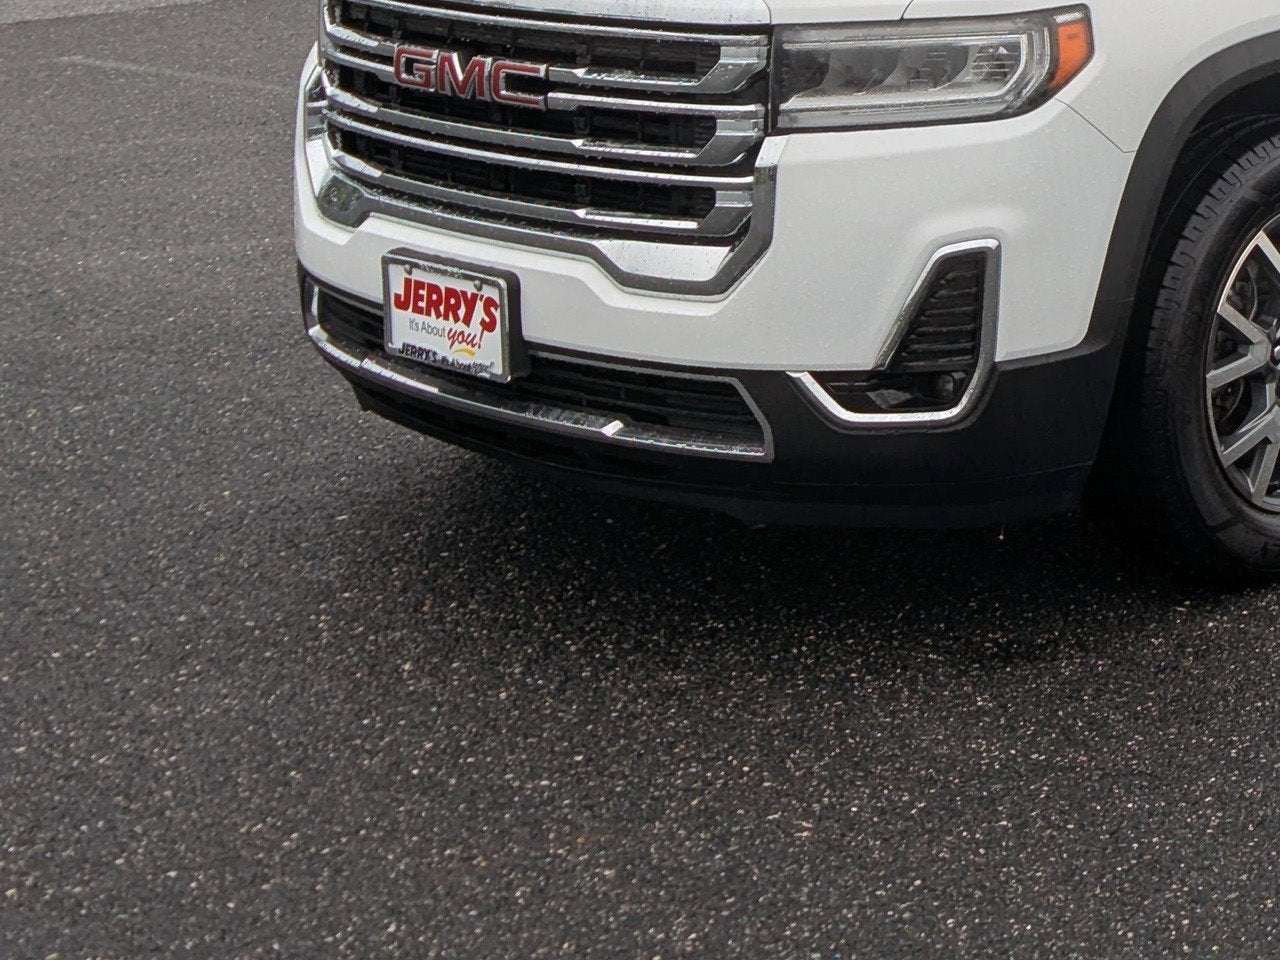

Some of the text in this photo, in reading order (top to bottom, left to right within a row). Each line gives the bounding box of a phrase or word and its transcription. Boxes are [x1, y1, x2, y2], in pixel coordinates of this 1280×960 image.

[394, 43, 548, 111] GMC
[393, 277, 500, 333] JERRY'S
[420, 320, 446, 338] About
[446, 327, 485, 350] you!
